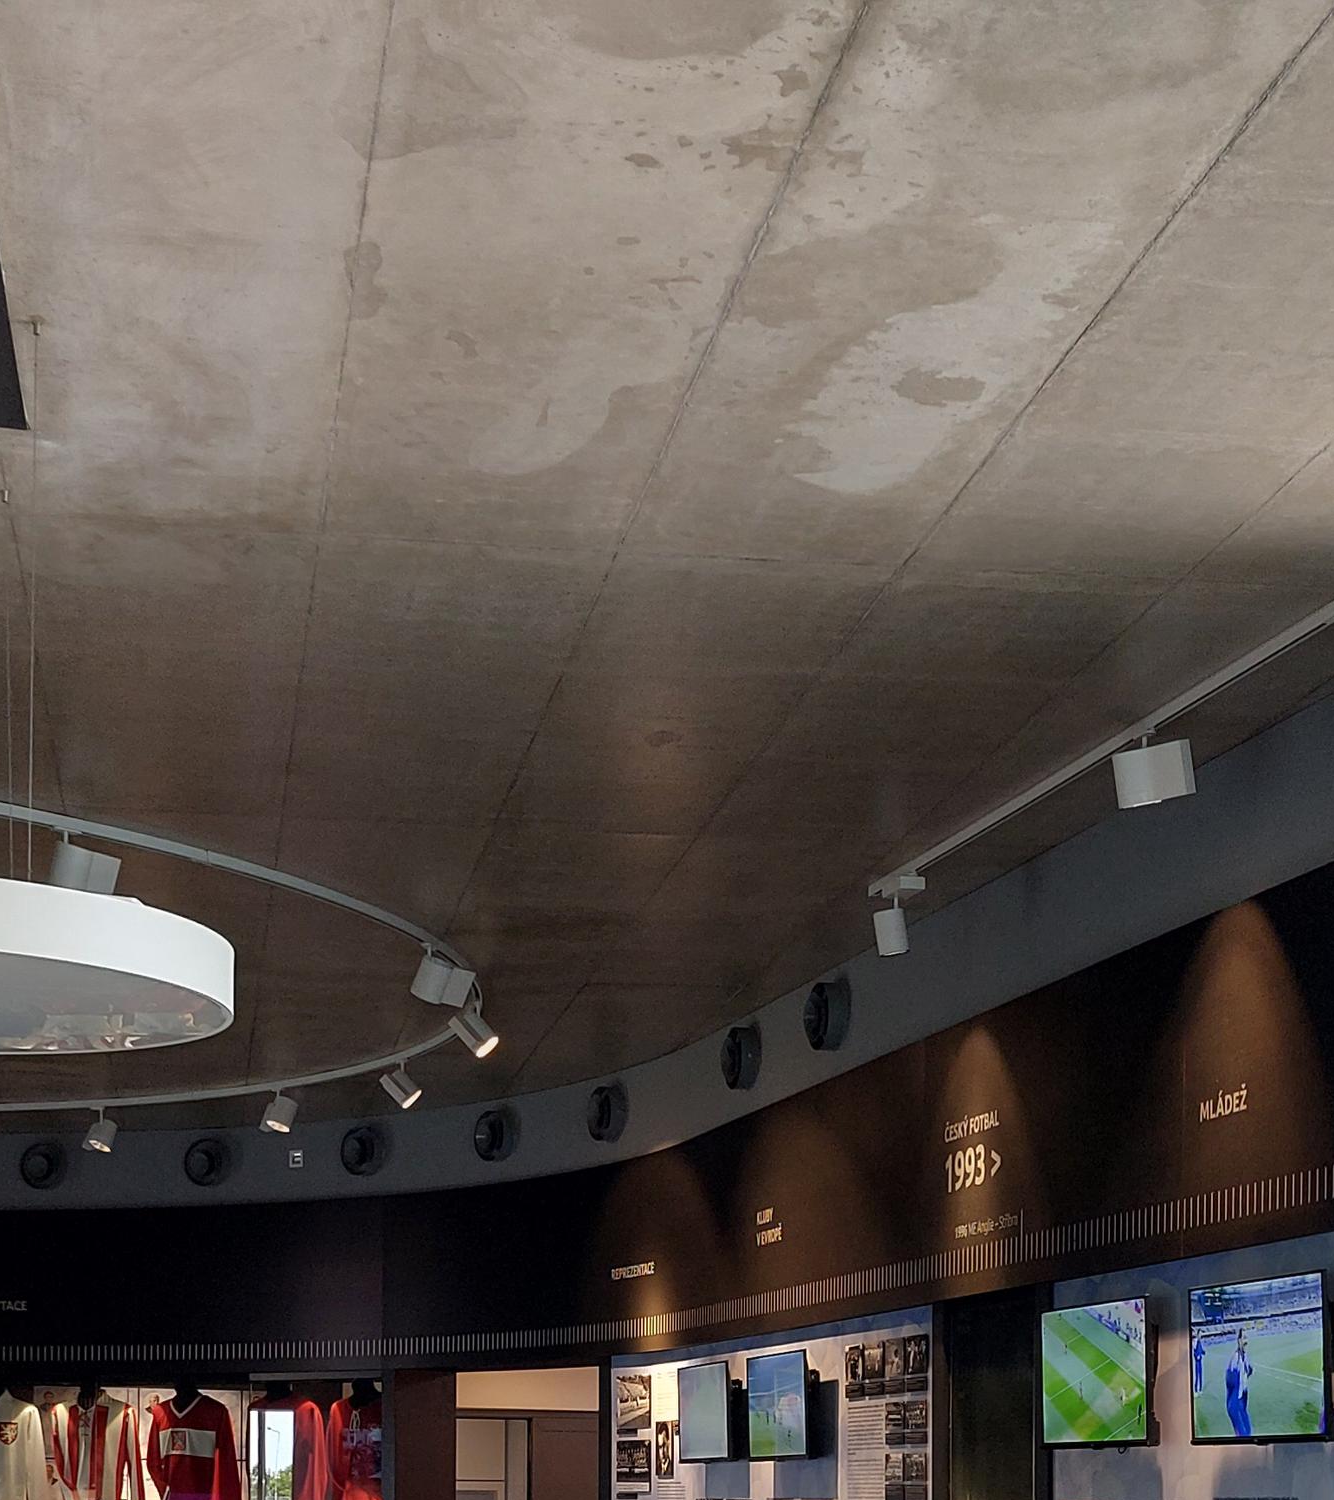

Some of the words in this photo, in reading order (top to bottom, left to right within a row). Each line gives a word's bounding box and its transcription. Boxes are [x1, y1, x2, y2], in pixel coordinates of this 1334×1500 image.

[1199, 1083, 1247, 1123] MLÁDEŽ
[944, 1115, 969, 1143] ČESKÝ
[969, 1109, 1000, 1135] FOTBAL
[945, 1143, 986, 1193] 1993
